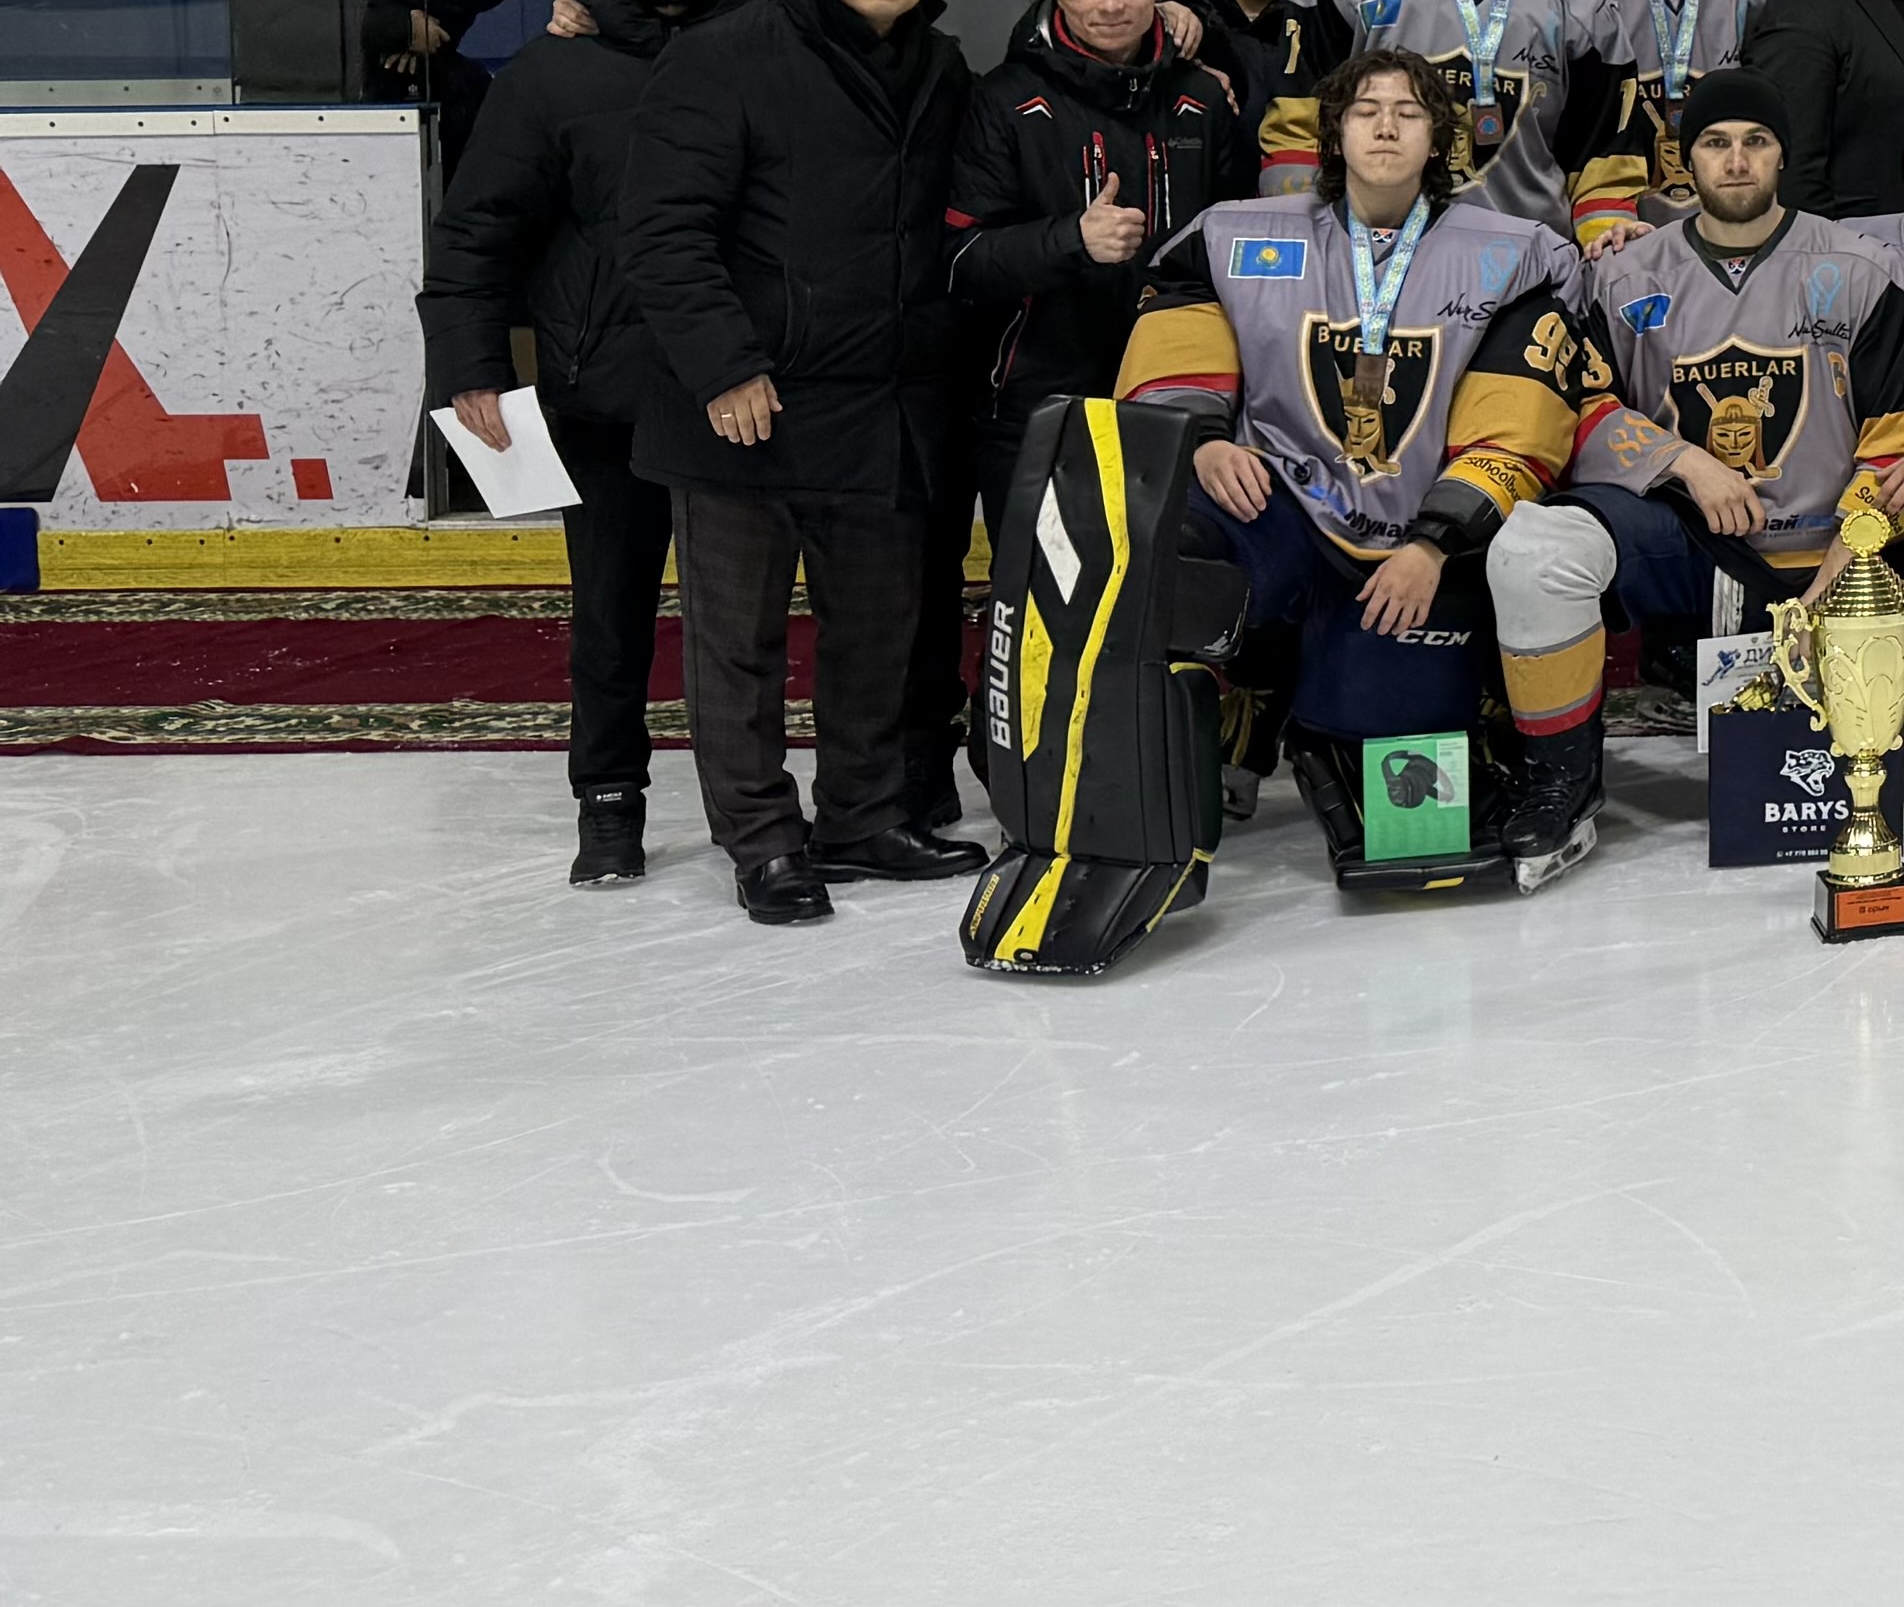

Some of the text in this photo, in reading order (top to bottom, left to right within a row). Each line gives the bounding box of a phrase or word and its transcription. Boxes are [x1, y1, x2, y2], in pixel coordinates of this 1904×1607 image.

[1671, 359, 1797, 384] BAUERLAR
[1397, 630, 1472, 648] CCM
[989, 601, 1015, 751] BAUER
[1765, 801, 1850, 824] BARYS
[1782, 825, 1827, 835] STORE
